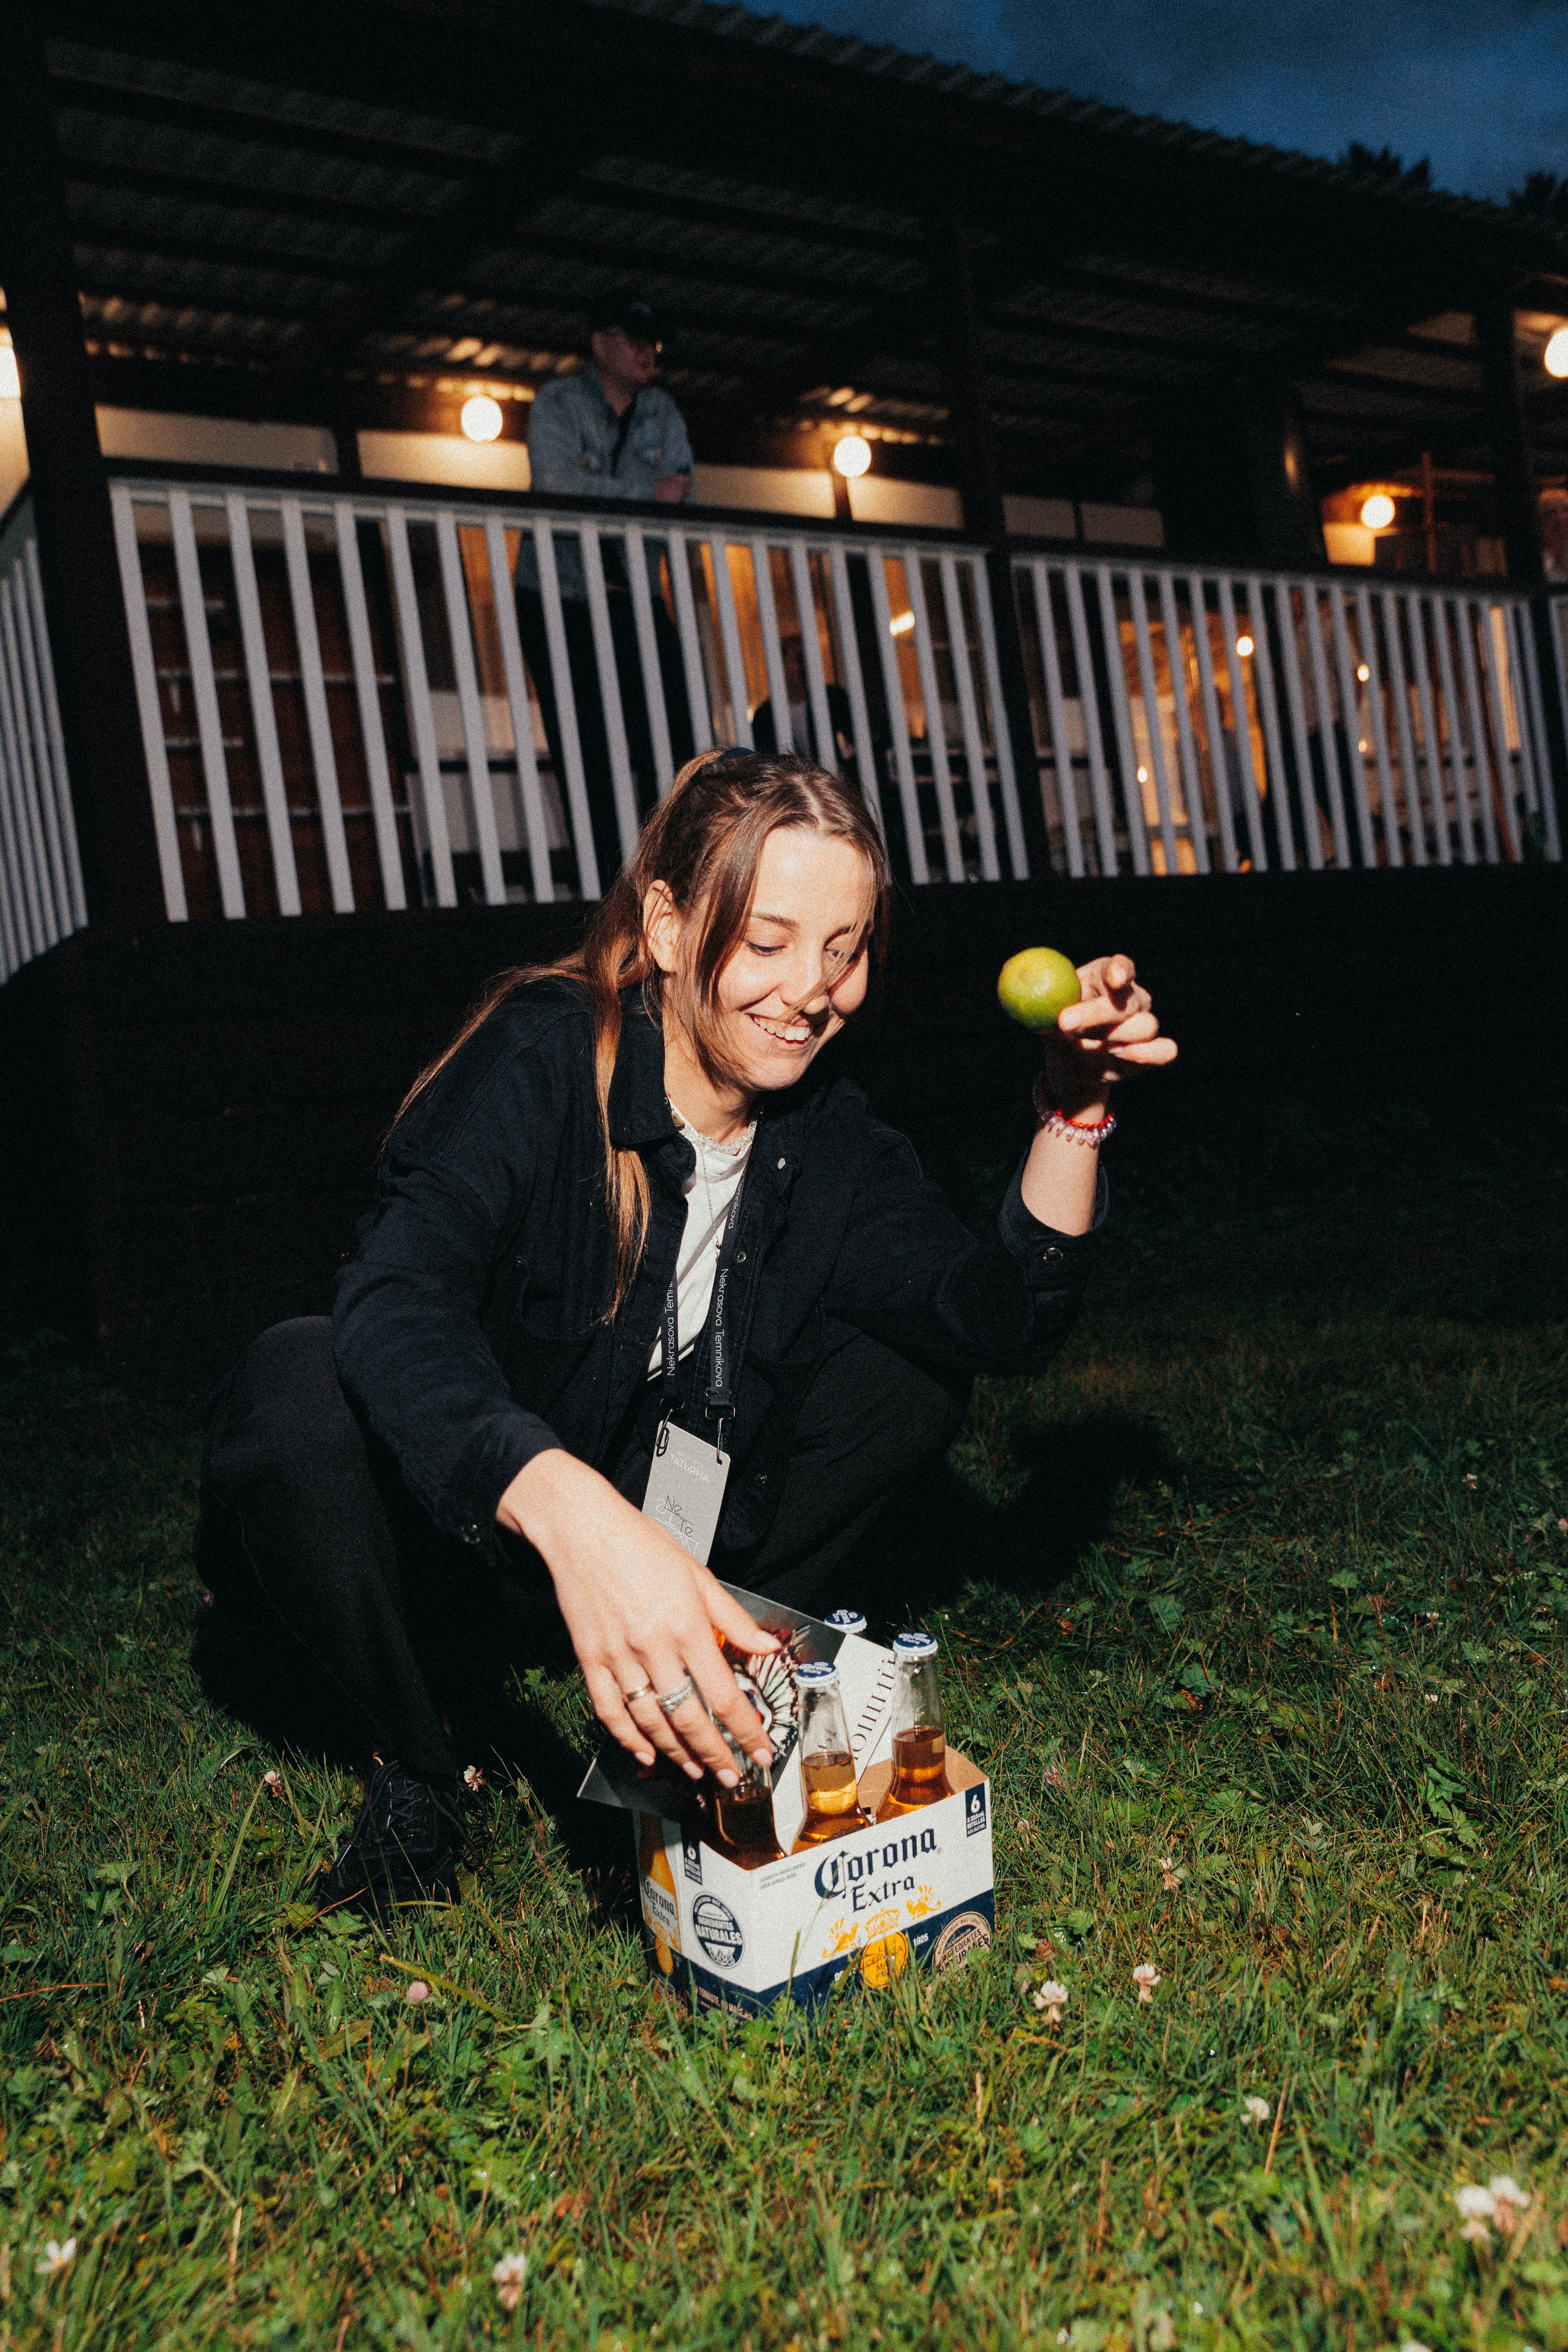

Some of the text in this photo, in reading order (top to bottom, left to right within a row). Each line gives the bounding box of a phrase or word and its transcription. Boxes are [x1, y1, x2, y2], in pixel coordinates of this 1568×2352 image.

[715, 1268, 729, 1387] Nekrasova Temnikova
[667, 1317, 676, 1376] Nekrasova
[669, 1453, 709, 1483] ТАТЬЯНА
[664, 1495, 682, 1515] Ne
[680, 1518, 693, 1537] Te
[971, 1794, 981, 1814] 6
[814, 1828, 938, 1899] Corona
[644, 1880, 675, 1915] Corona
[851, 1876, 916, 1913] Extra
[652, 1902, 671, 1926] Extra
[695, 1924, 743, 1945] NATURALES
[913, 1932, 929, 1946] 1925
